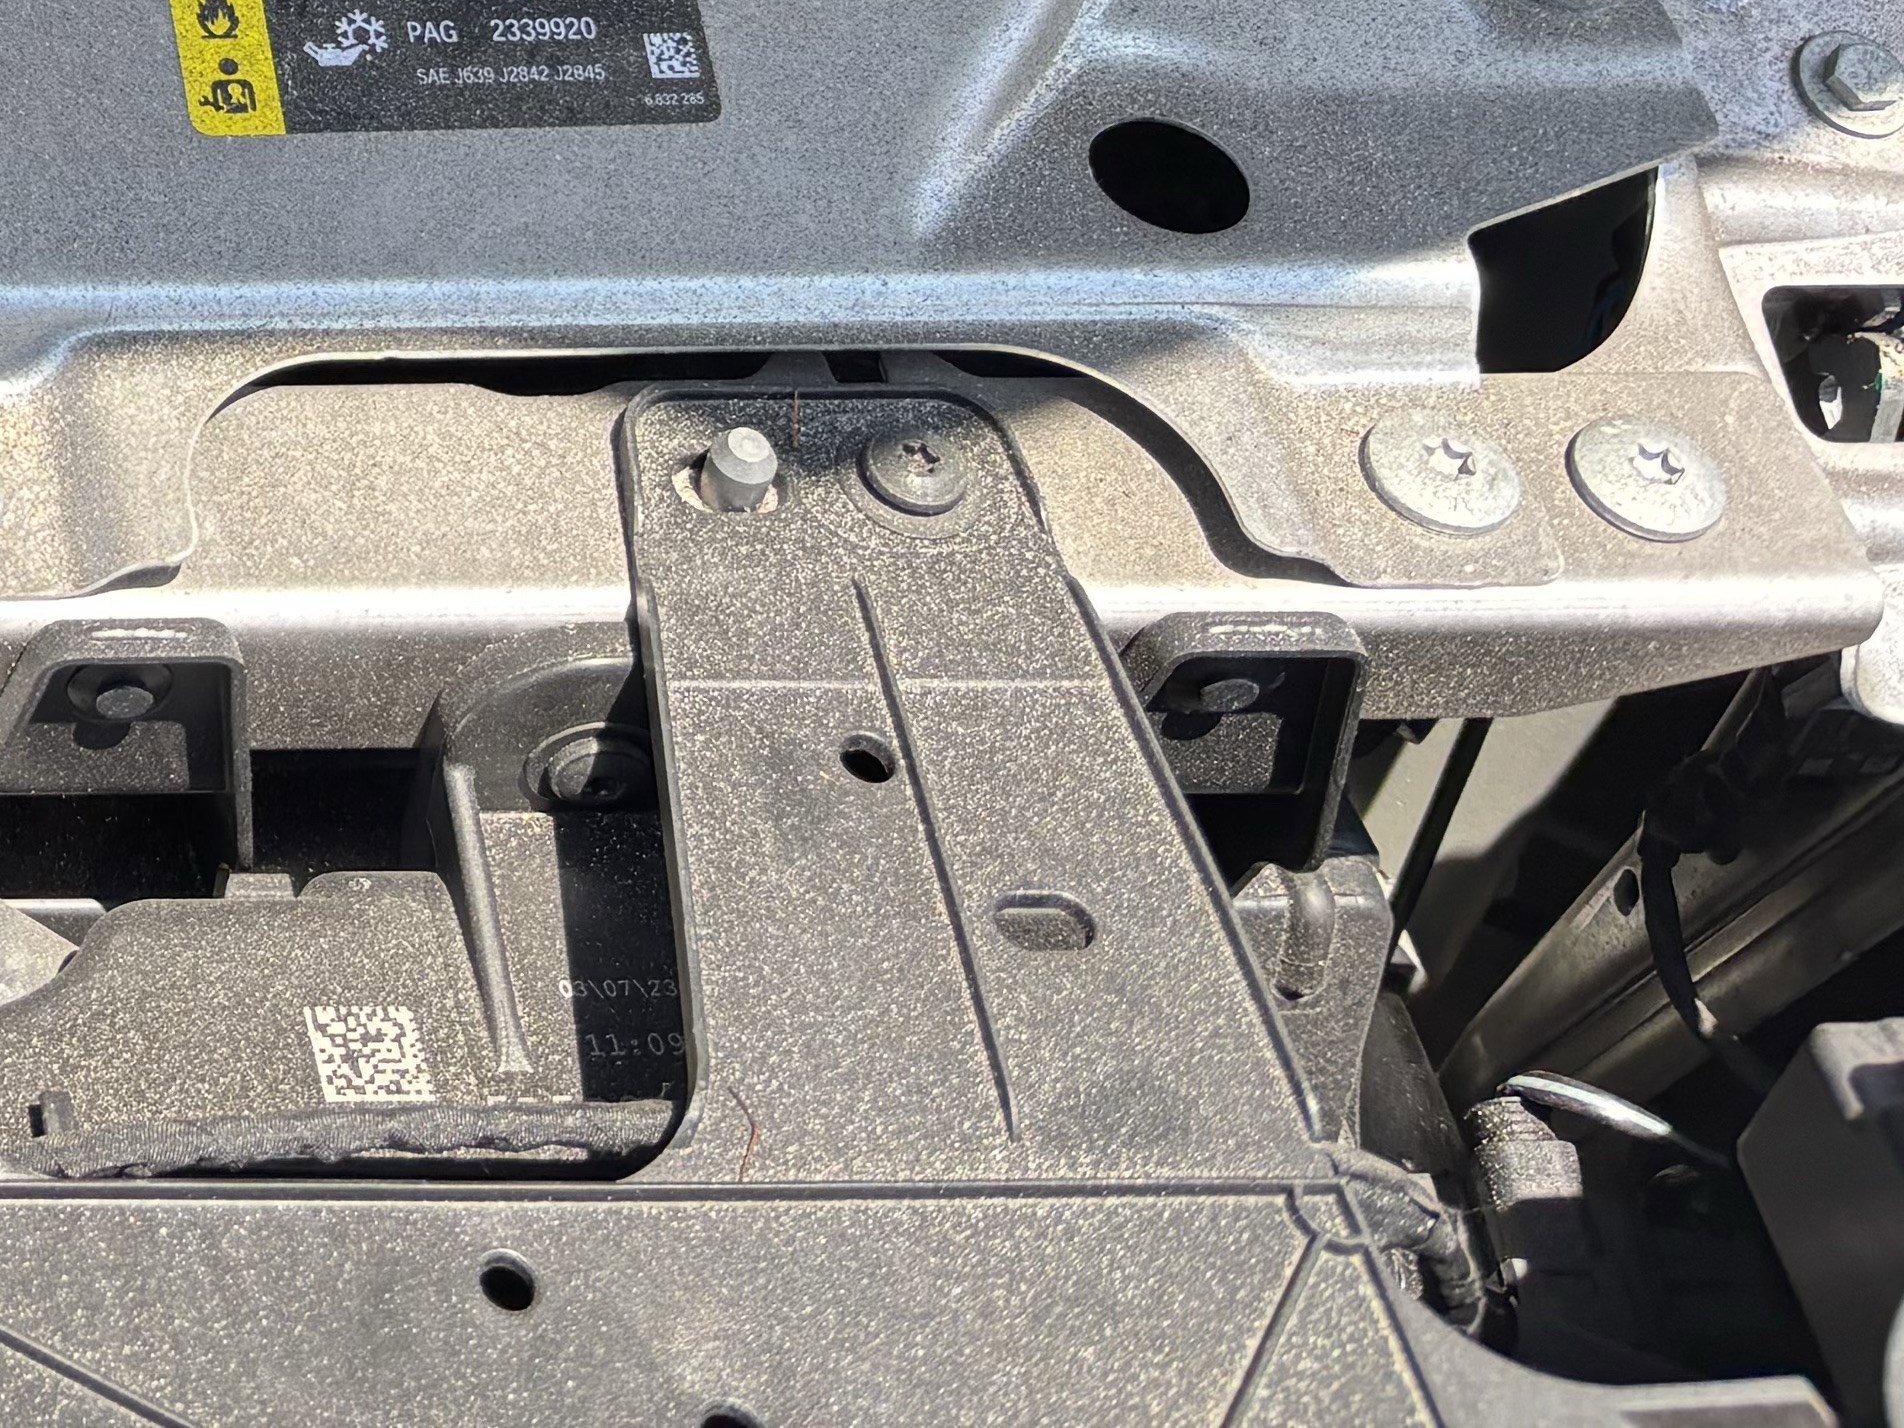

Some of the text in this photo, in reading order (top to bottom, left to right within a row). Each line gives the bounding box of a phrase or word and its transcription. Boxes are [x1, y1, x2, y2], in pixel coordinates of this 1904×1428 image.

[407, 16, 597, 44] PAG 2339920
[417, 63, 606, 85] SAE J639 J2842 J2845
